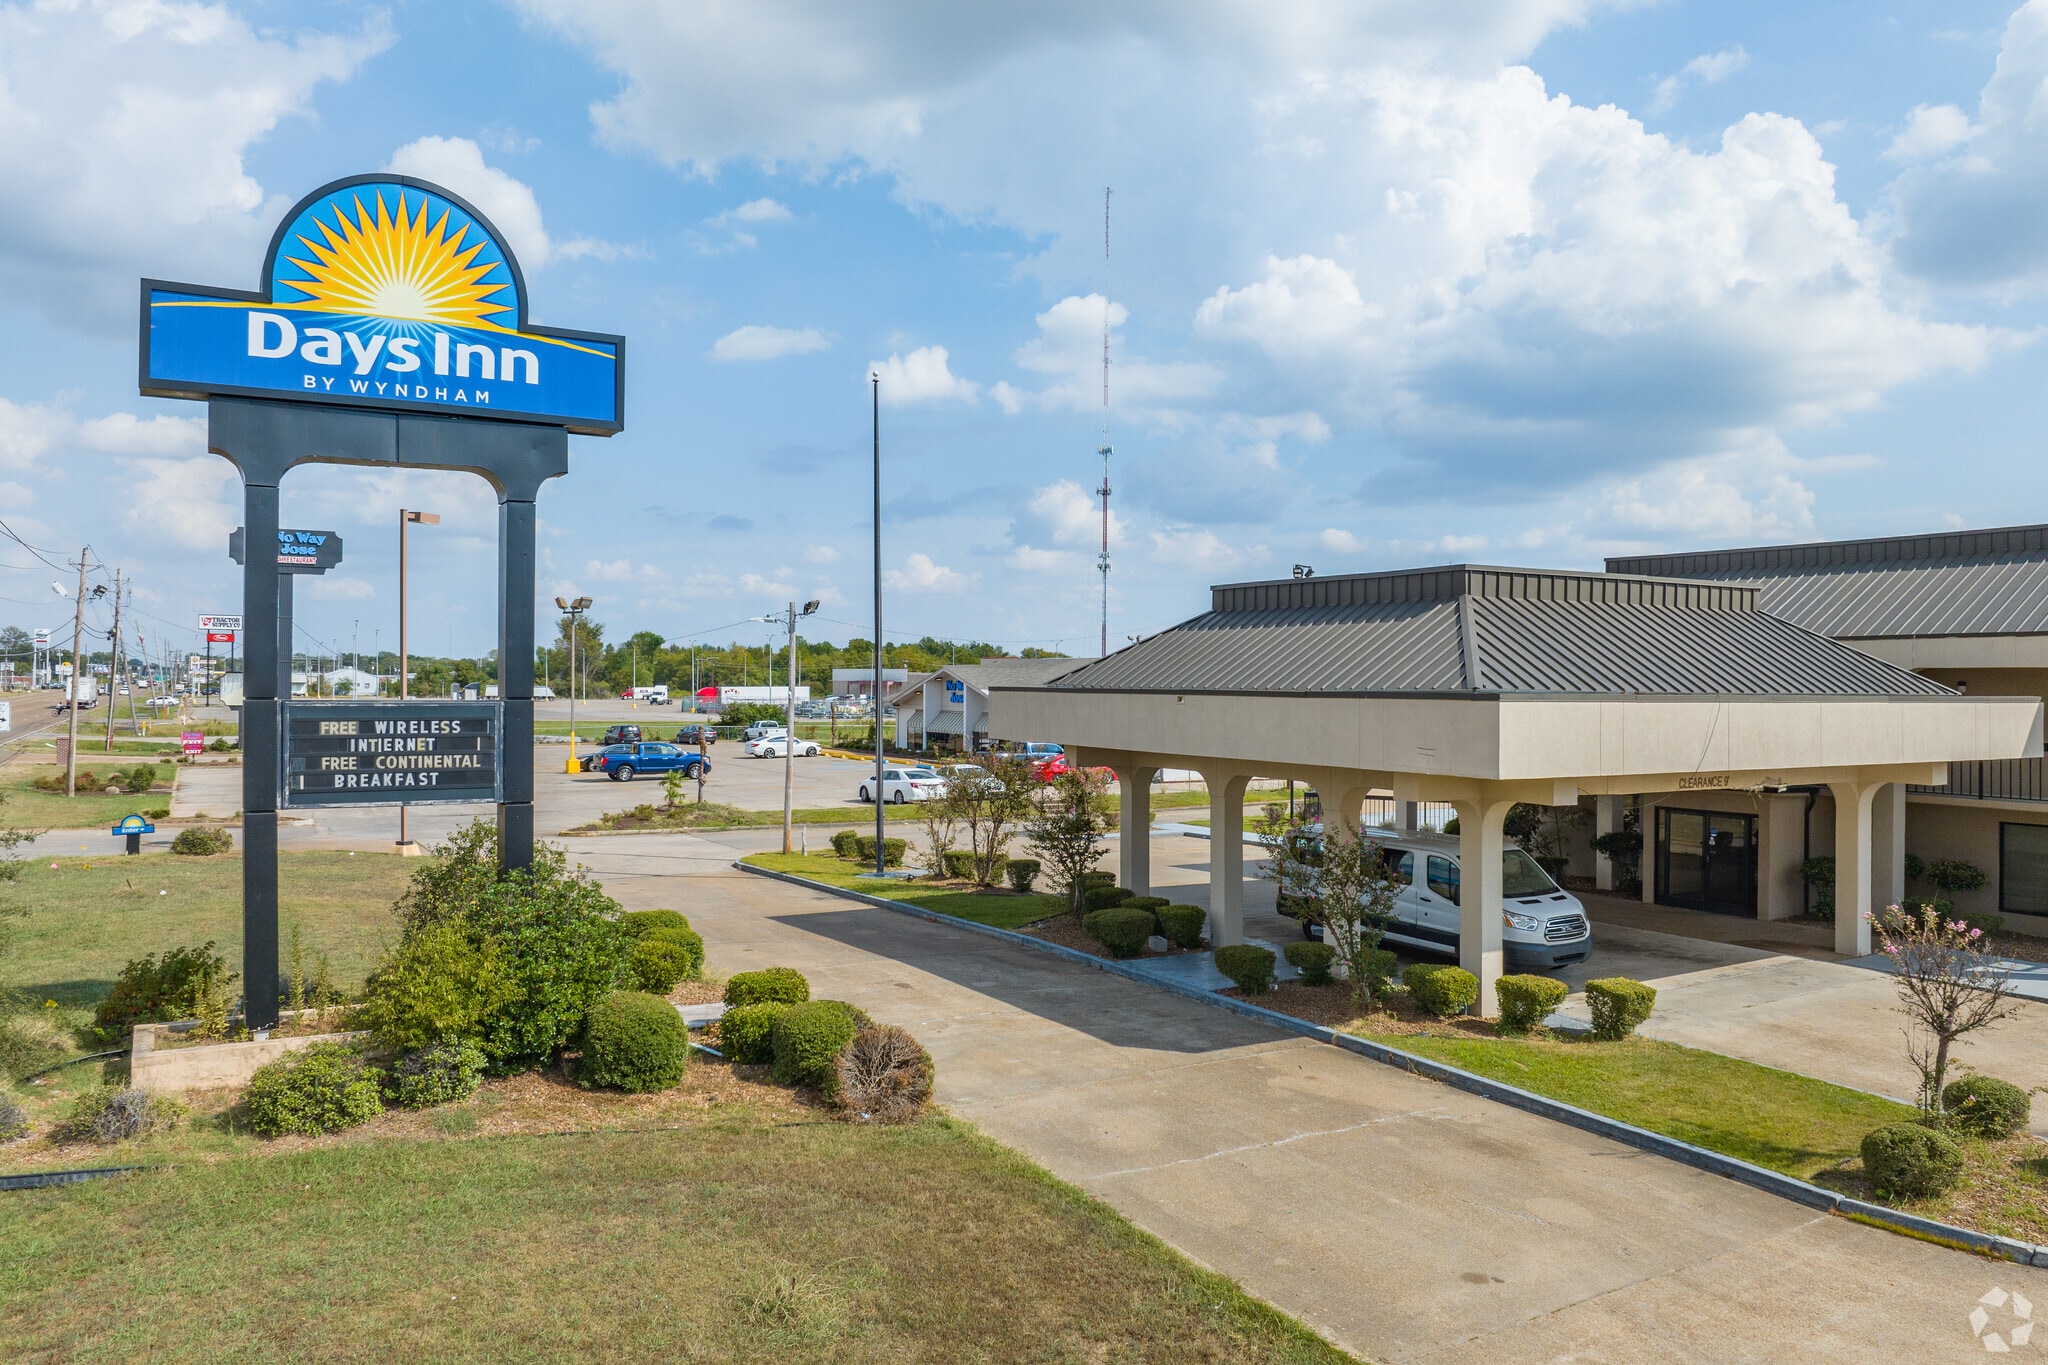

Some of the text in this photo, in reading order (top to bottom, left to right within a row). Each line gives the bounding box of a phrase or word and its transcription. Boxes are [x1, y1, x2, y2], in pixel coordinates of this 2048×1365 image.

[247, 310, 539, 385] Days Inn
[303, 374, 490, 404] BY WYNDHAM
[295, 532, 326, 546] Way
[280, 543, 317, 555] Jose
[320, 720, 462, 735] FREE WIRELESS
[321, 754, 481, 770] FREE CONTINENTAL
[334, 772, 439, 788] BREAKFAST
[1679, 776, 1722, 789] CLEARANCE
